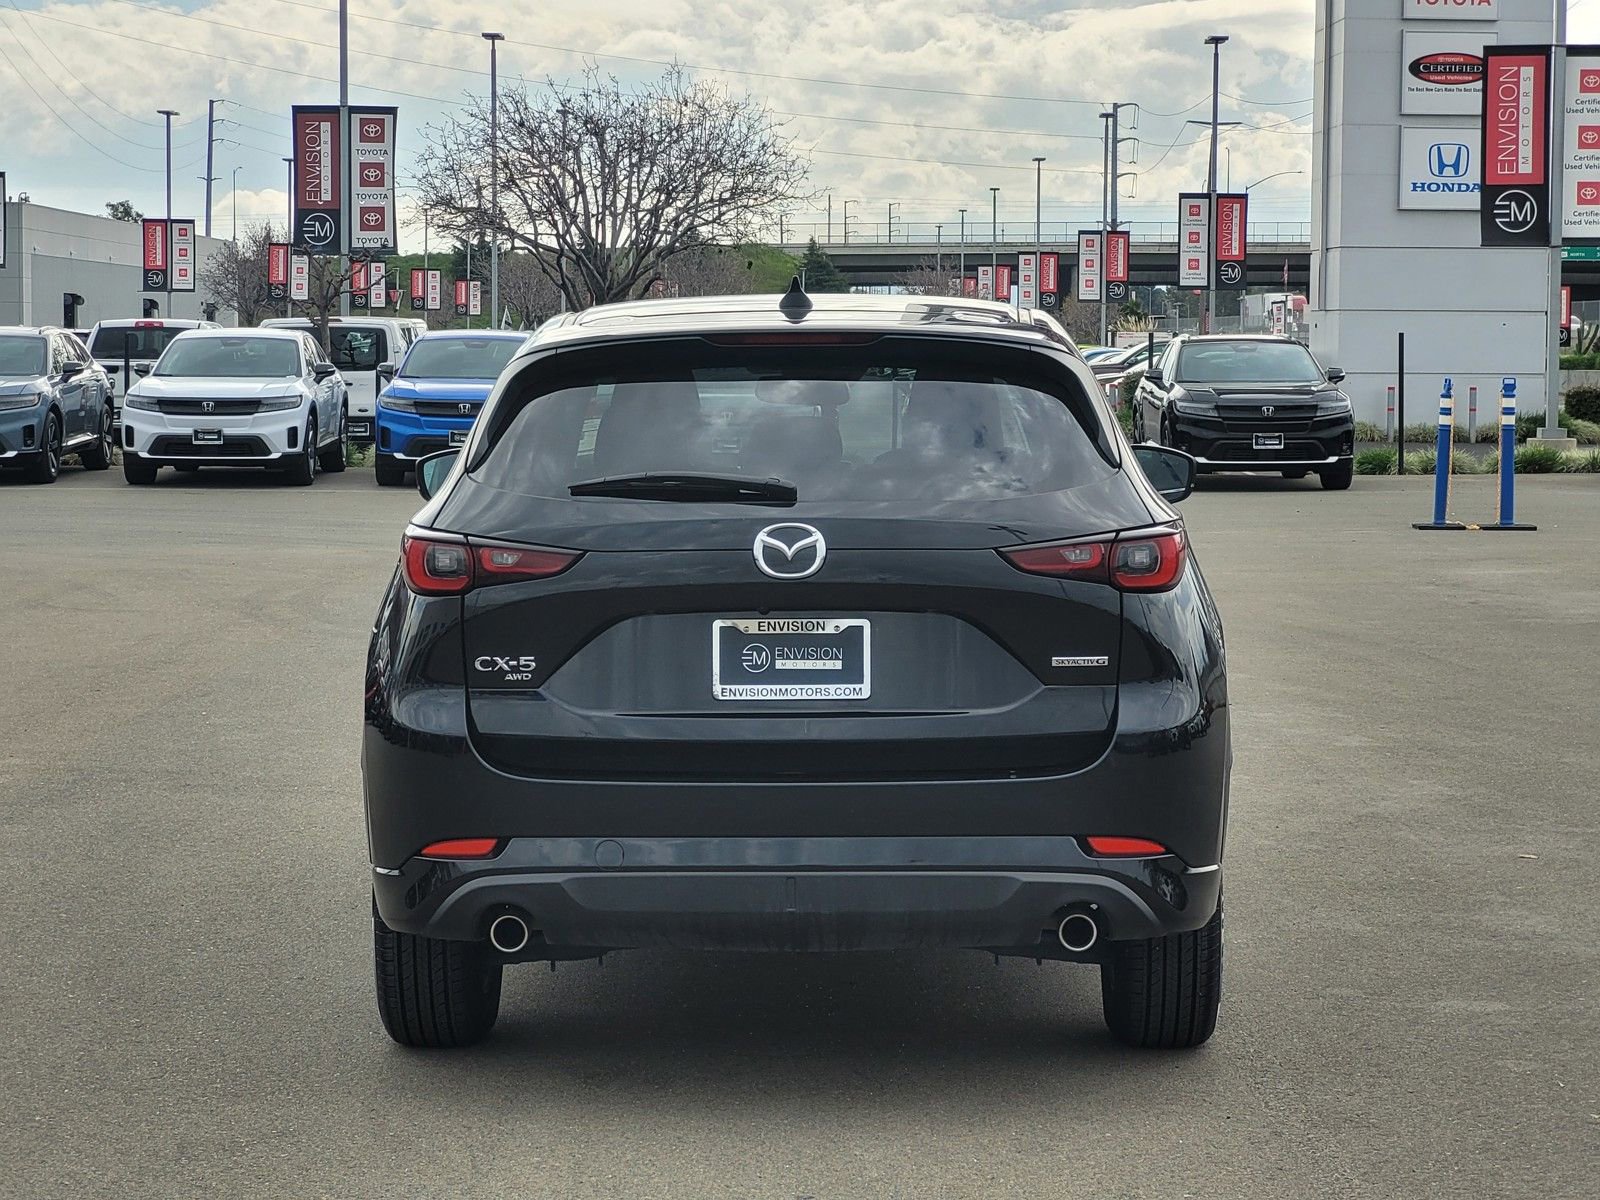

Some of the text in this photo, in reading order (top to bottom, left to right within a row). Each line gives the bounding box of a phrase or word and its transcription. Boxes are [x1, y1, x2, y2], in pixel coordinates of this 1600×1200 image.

[1420, 63, 1482, 73] CERTIFIED
[1497, 66, 1519, 175] ENVISION
[1522, 75, 1531, 165] MOTORS
[306, 122, 320, 201] ENVISION
[1410, 182, 1480, 192] HONDA
[1222, 204, 1233, 256] ENVISION
[757, 620, 826, 632] ENVISION
[775, 648, 843, 660] ENVISION
[474, 656, 536, 672] CX-5
[720, 688, 863, 698] ENVISIONMOTORS.COM
